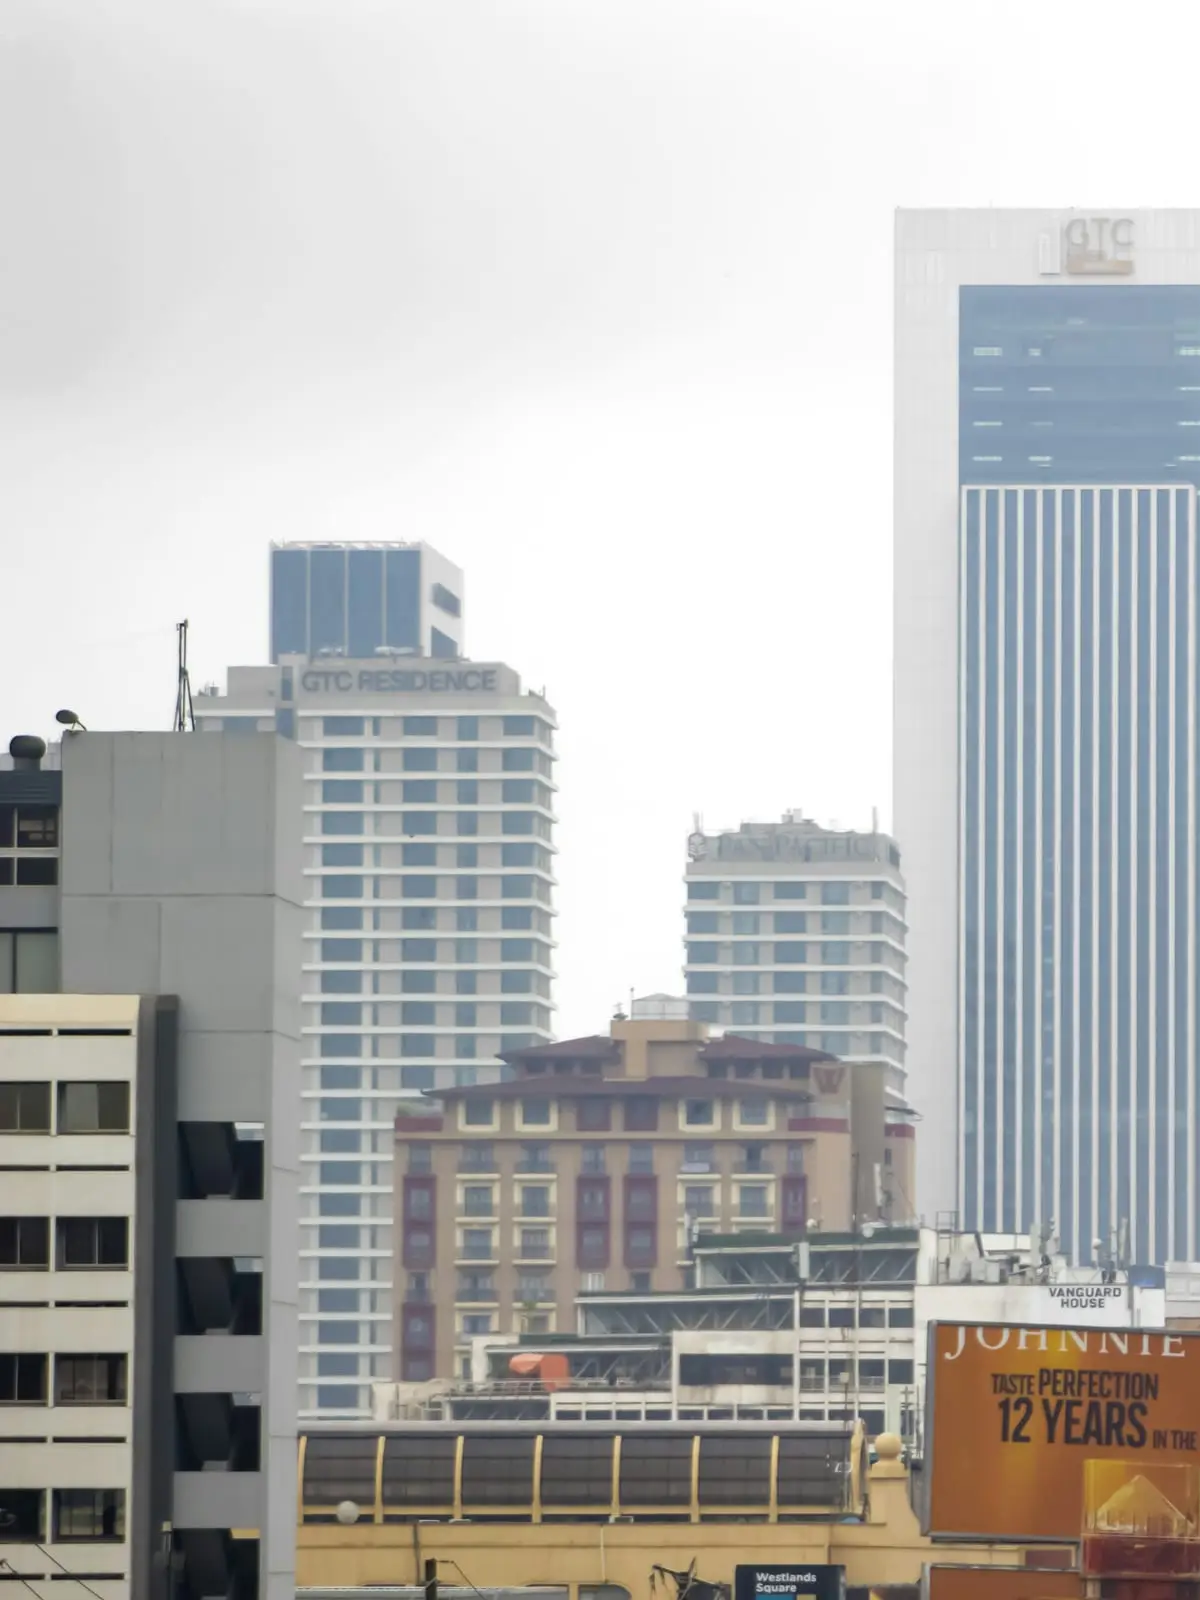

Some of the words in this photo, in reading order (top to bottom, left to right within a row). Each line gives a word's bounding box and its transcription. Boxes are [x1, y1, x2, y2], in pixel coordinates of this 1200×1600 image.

[1065, 217, 1135, 247] GTC
[302, 669, 353, 692] GTC
[358, 669, 498, 692] RESIDENCE
[1049, 1287, 1122, 1298] VANGUARD
[1061, 1298, 1105, 1308] HOUSE
[944, 1326, 1186, 1360] JOHNNIE
[991, 1373, 1035, 1395] TASTE
[1038, 1368, 1159, 1401] PERFECTION
[998, 1397, 1034, 1443] 12
[1041, 1399, 1148, 1448] YEARS
[1152, 1429, 1168, 1449] IN
[1170, 1430, 1198, 1451] THE
[755, 1572, 817, 1582] Westlands
[755, 1583, 797, 1593] Square
